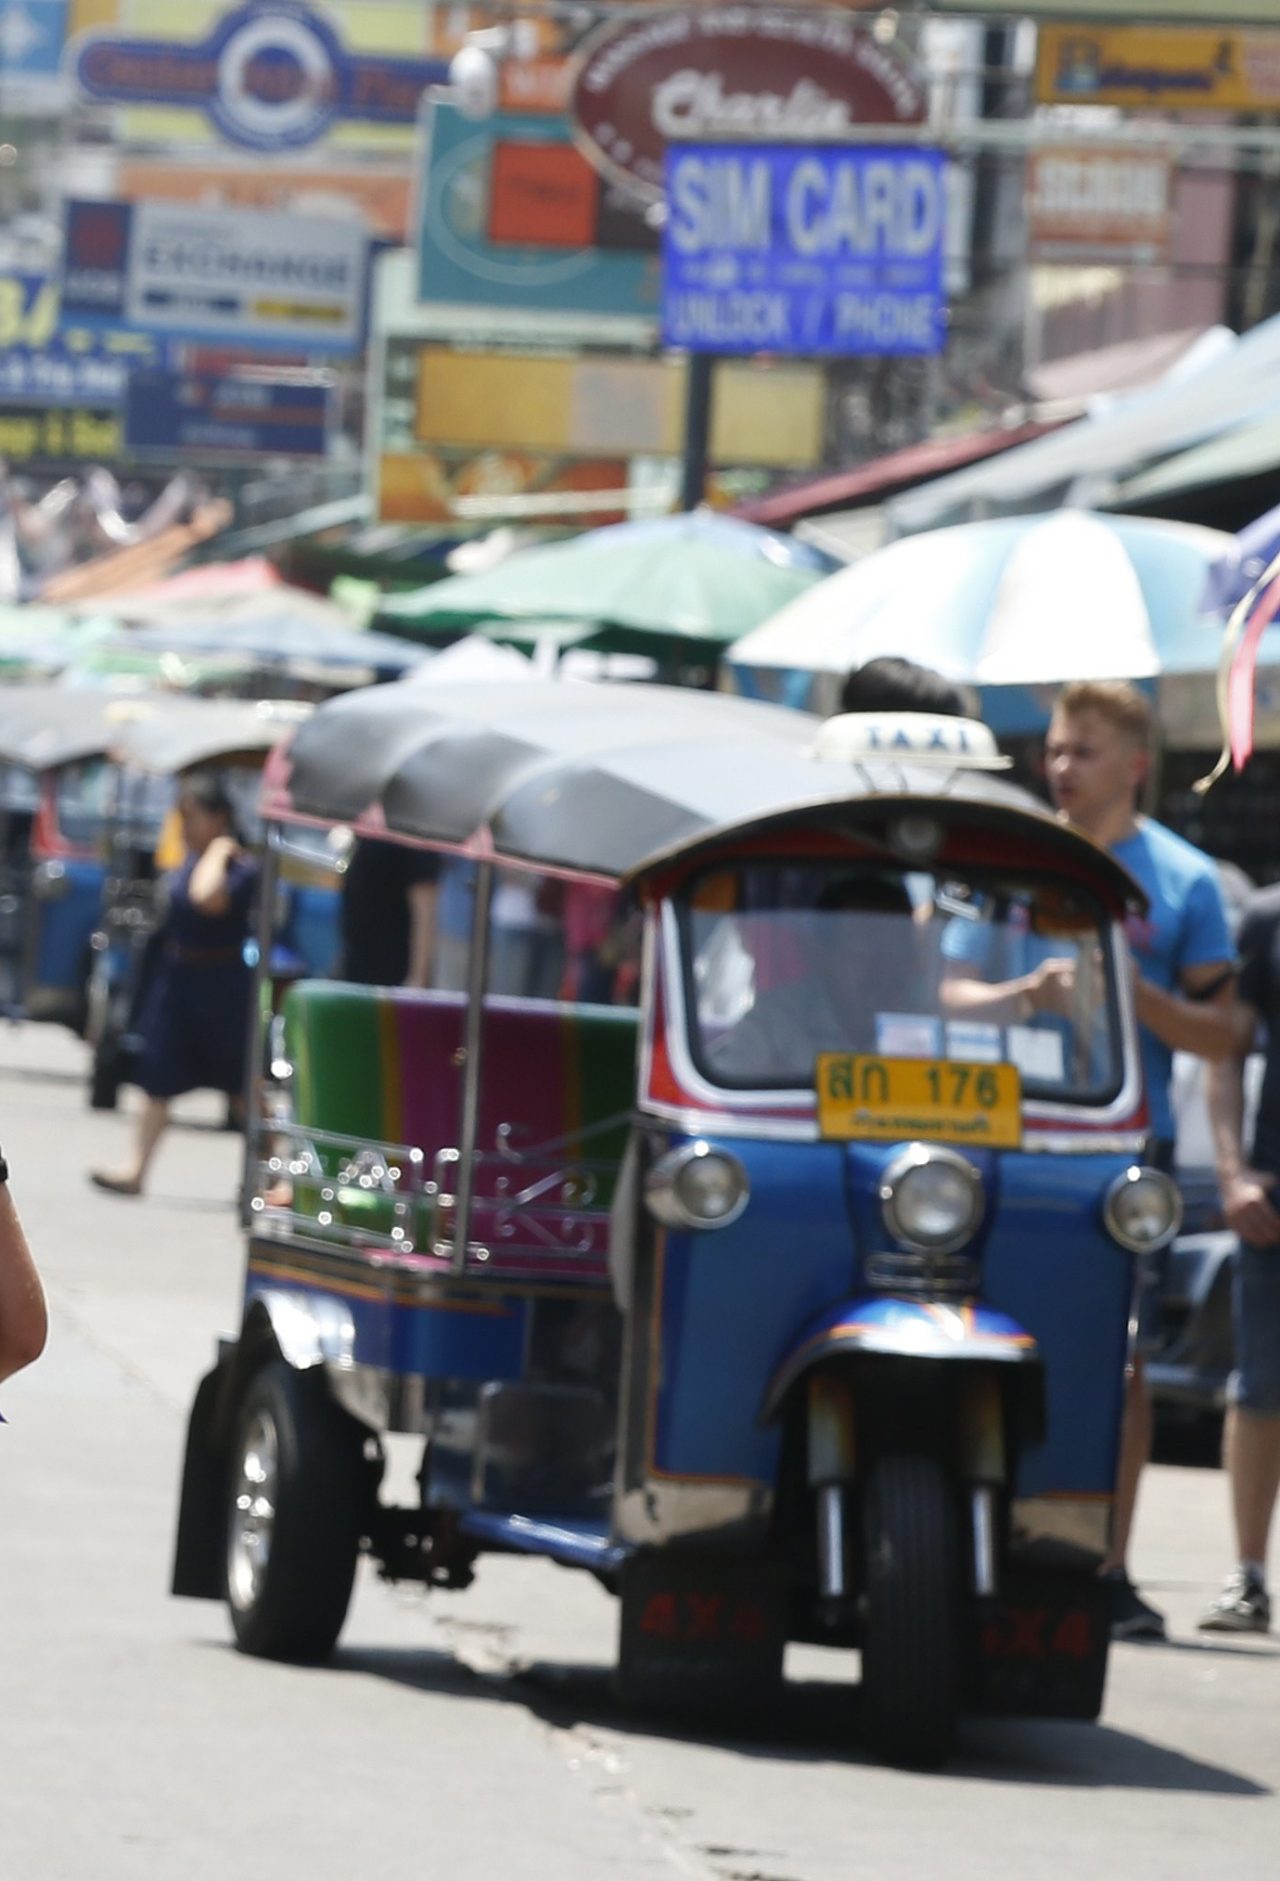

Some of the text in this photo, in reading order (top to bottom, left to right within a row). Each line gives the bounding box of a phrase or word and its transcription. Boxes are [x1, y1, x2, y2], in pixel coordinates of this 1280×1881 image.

[673, 156, 770, 253] SIM
[787, 156, 940, 255] CARD
[672, 292, 790, 343] UNLOCK
[836, 292, 936, 346] PHONE
[865, 725, 971, 753] TAXI
[926, 1066, 999, 1108] 176
